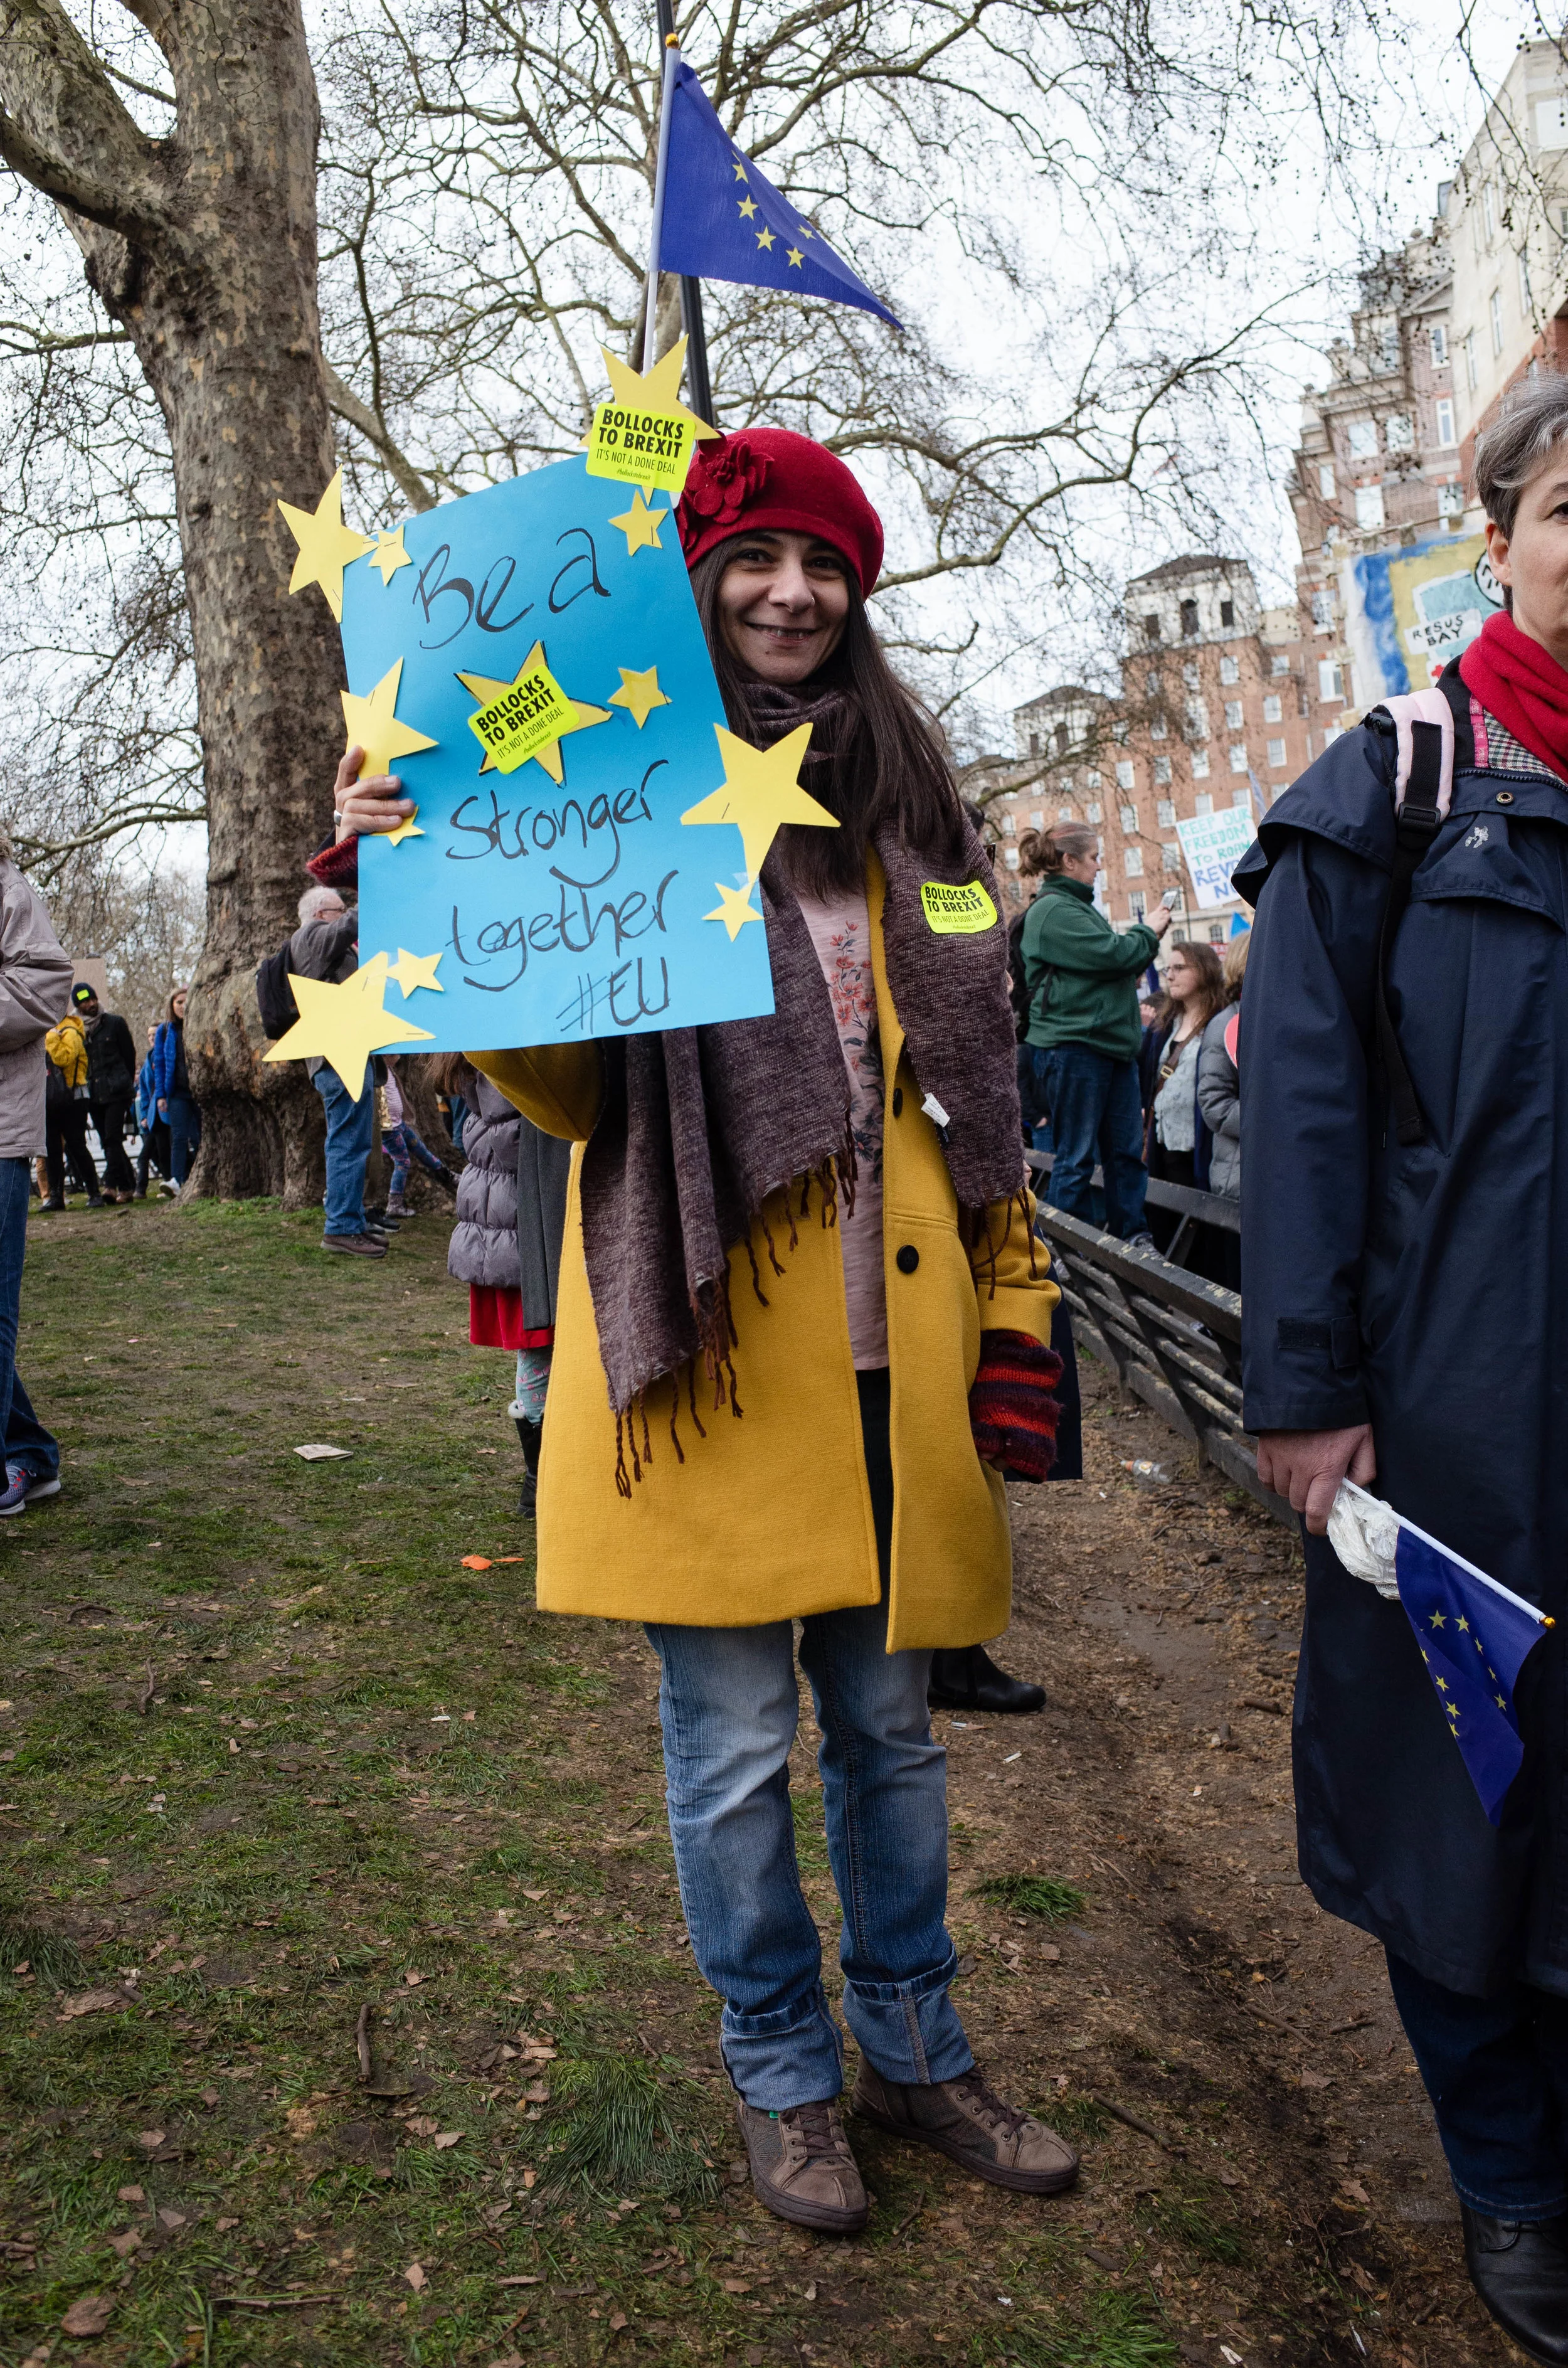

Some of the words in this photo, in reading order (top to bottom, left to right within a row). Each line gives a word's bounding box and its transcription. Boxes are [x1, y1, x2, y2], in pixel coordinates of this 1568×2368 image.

[602, 409, 684, 439] BOLLOCKS
[599, 427, 618, 445] TO
[623, 432, 682, 458] BREXIT
[596, 449, 609, 461] IT'S
[612, 452, 625, 464] NOT
[627, 455, 632, 465] A
[635, 457, 655, 470] DONE
[657, 461, 675, 474] DEAL
[617, 469, 651, 480] #bollockstobrexit
[411, 543, 534, 650] Be
[548, 528, 612, 614] a
[1412, 615, 1464, 640] RESUS
[1427, 628, 1463, 647] BAY
[476, 674, 545, 732] BOLLOCKS
[485, 726, 505, 746] TO
[505, 688, 555, 732] BREXIT
[497, 745, 511, 759] IT'S
[511, 735, 524, 751] NOT
[524, 731, 529, 740] A
[528, 718, 548, 736] DONE
[546, 707, 564, 723] DEAL
[445, 758, 670, 888] Stronger
[1179, 816, 1215, 836] KEEP
[1223, 808, 1253, 826] OUR
[1184, 823, 1249, 854] FREEDOM
[925, 886, 976, 901] BOLLOCKS
[926, 900, 940, 912] TO
[942, 897, 983, 913] BREXIT
[445, 869, 679, 992] together
[942, 915, 953, 923] NOT
[959, 915, 973, 923] DONE
[973, 910, 990, 920] DEAL
[556, 955, 671, 1035] #EU
